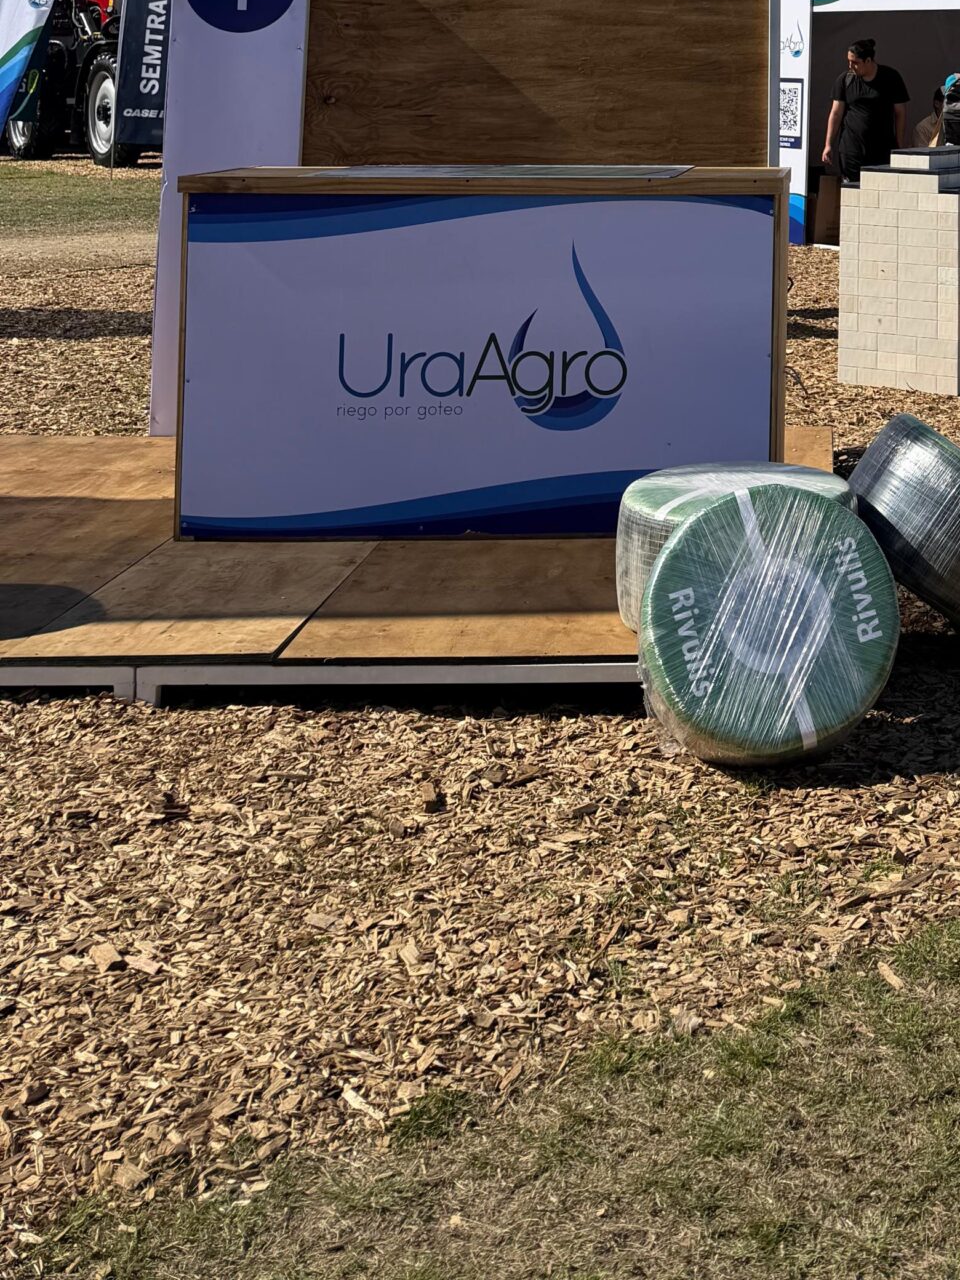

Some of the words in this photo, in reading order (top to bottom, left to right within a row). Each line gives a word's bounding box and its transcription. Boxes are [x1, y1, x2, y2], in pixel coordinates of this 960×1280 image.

[123, 108, 159, 118] CASE
[339, 332, 628, 414] UraAgro
[336, 404, 378, 420] riego
[384, 406, 411, 420] por
[417, 401, 464, 420] goteo
[834, 536, 884, 644] Rivulis
